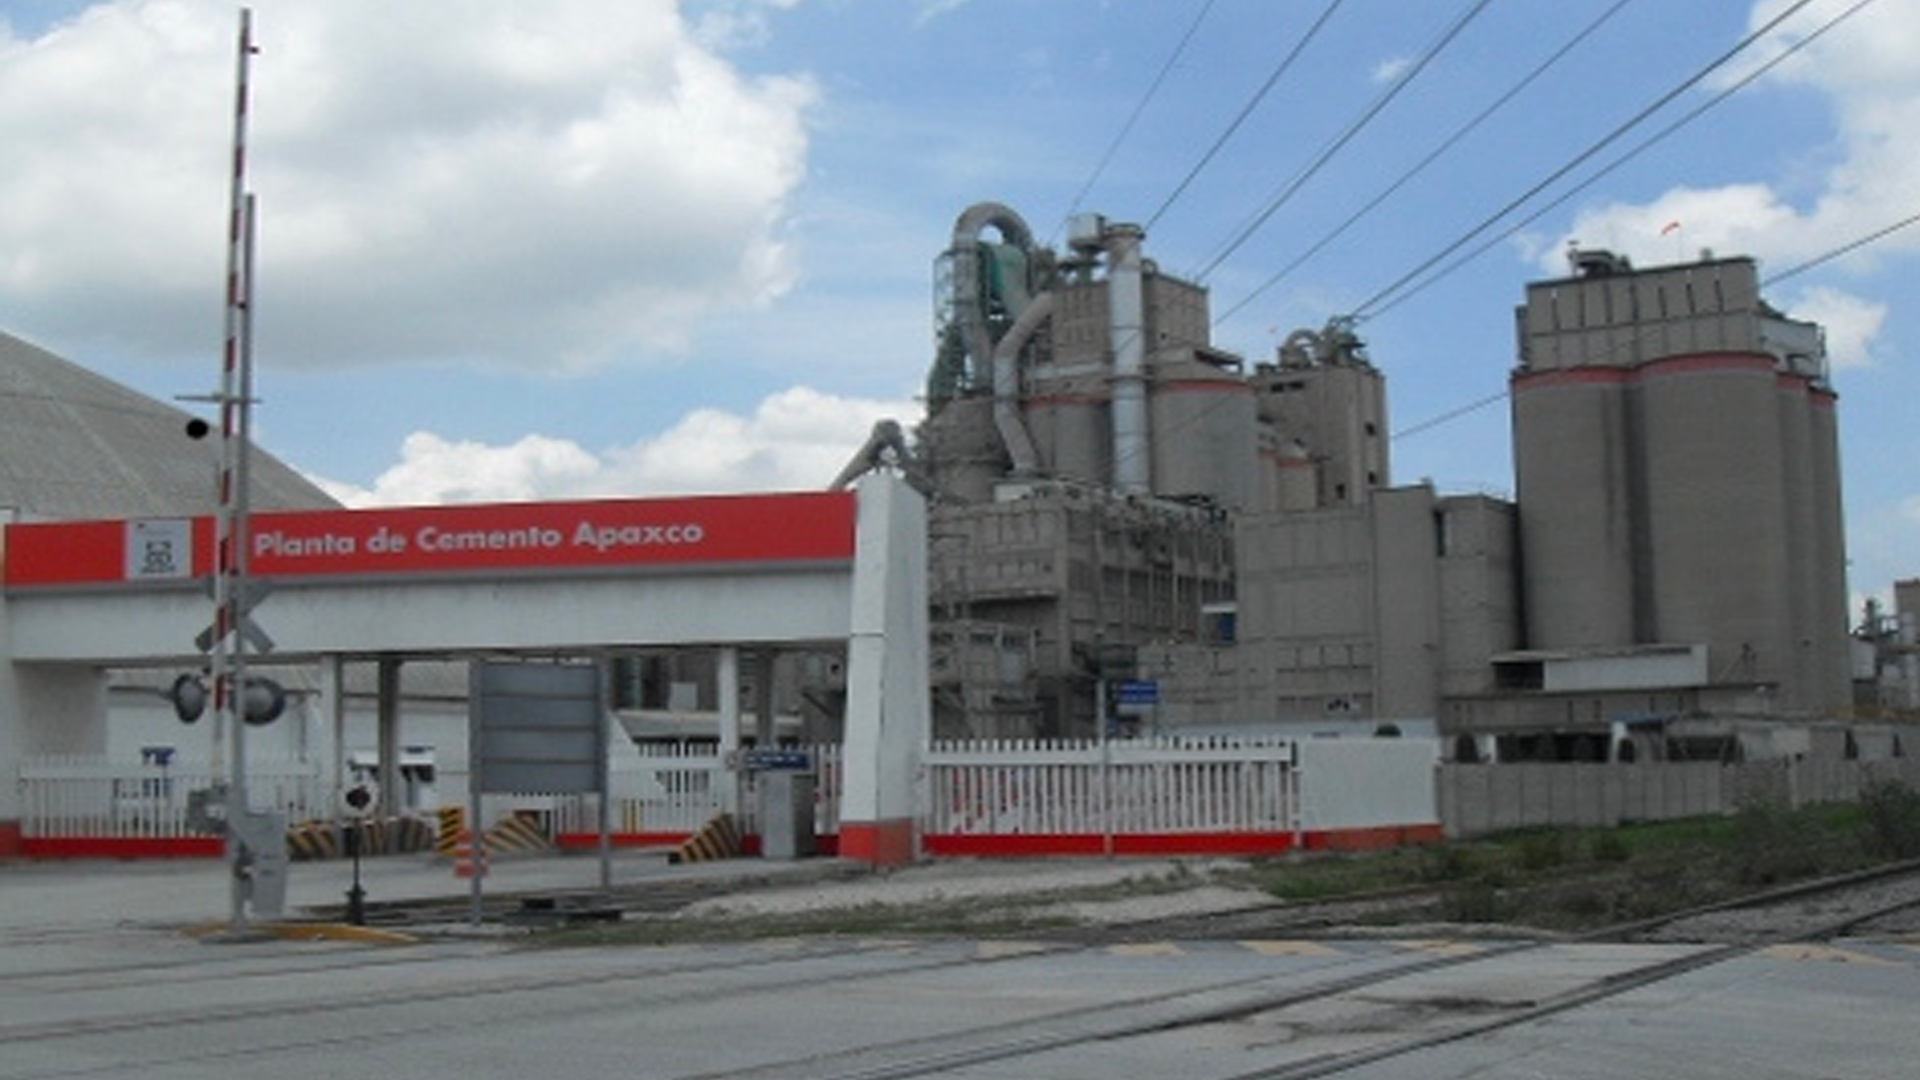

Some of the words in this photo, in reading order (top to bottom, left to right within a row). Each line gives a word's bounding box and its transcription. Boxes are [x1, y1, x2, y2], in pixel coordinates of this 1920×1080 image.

[254, 530, 355, 557] Planta
[367, 527, 407, 554] de
[416, 525, 562, 553] Cemento
[572, 520, 704, 551] Apaxco
